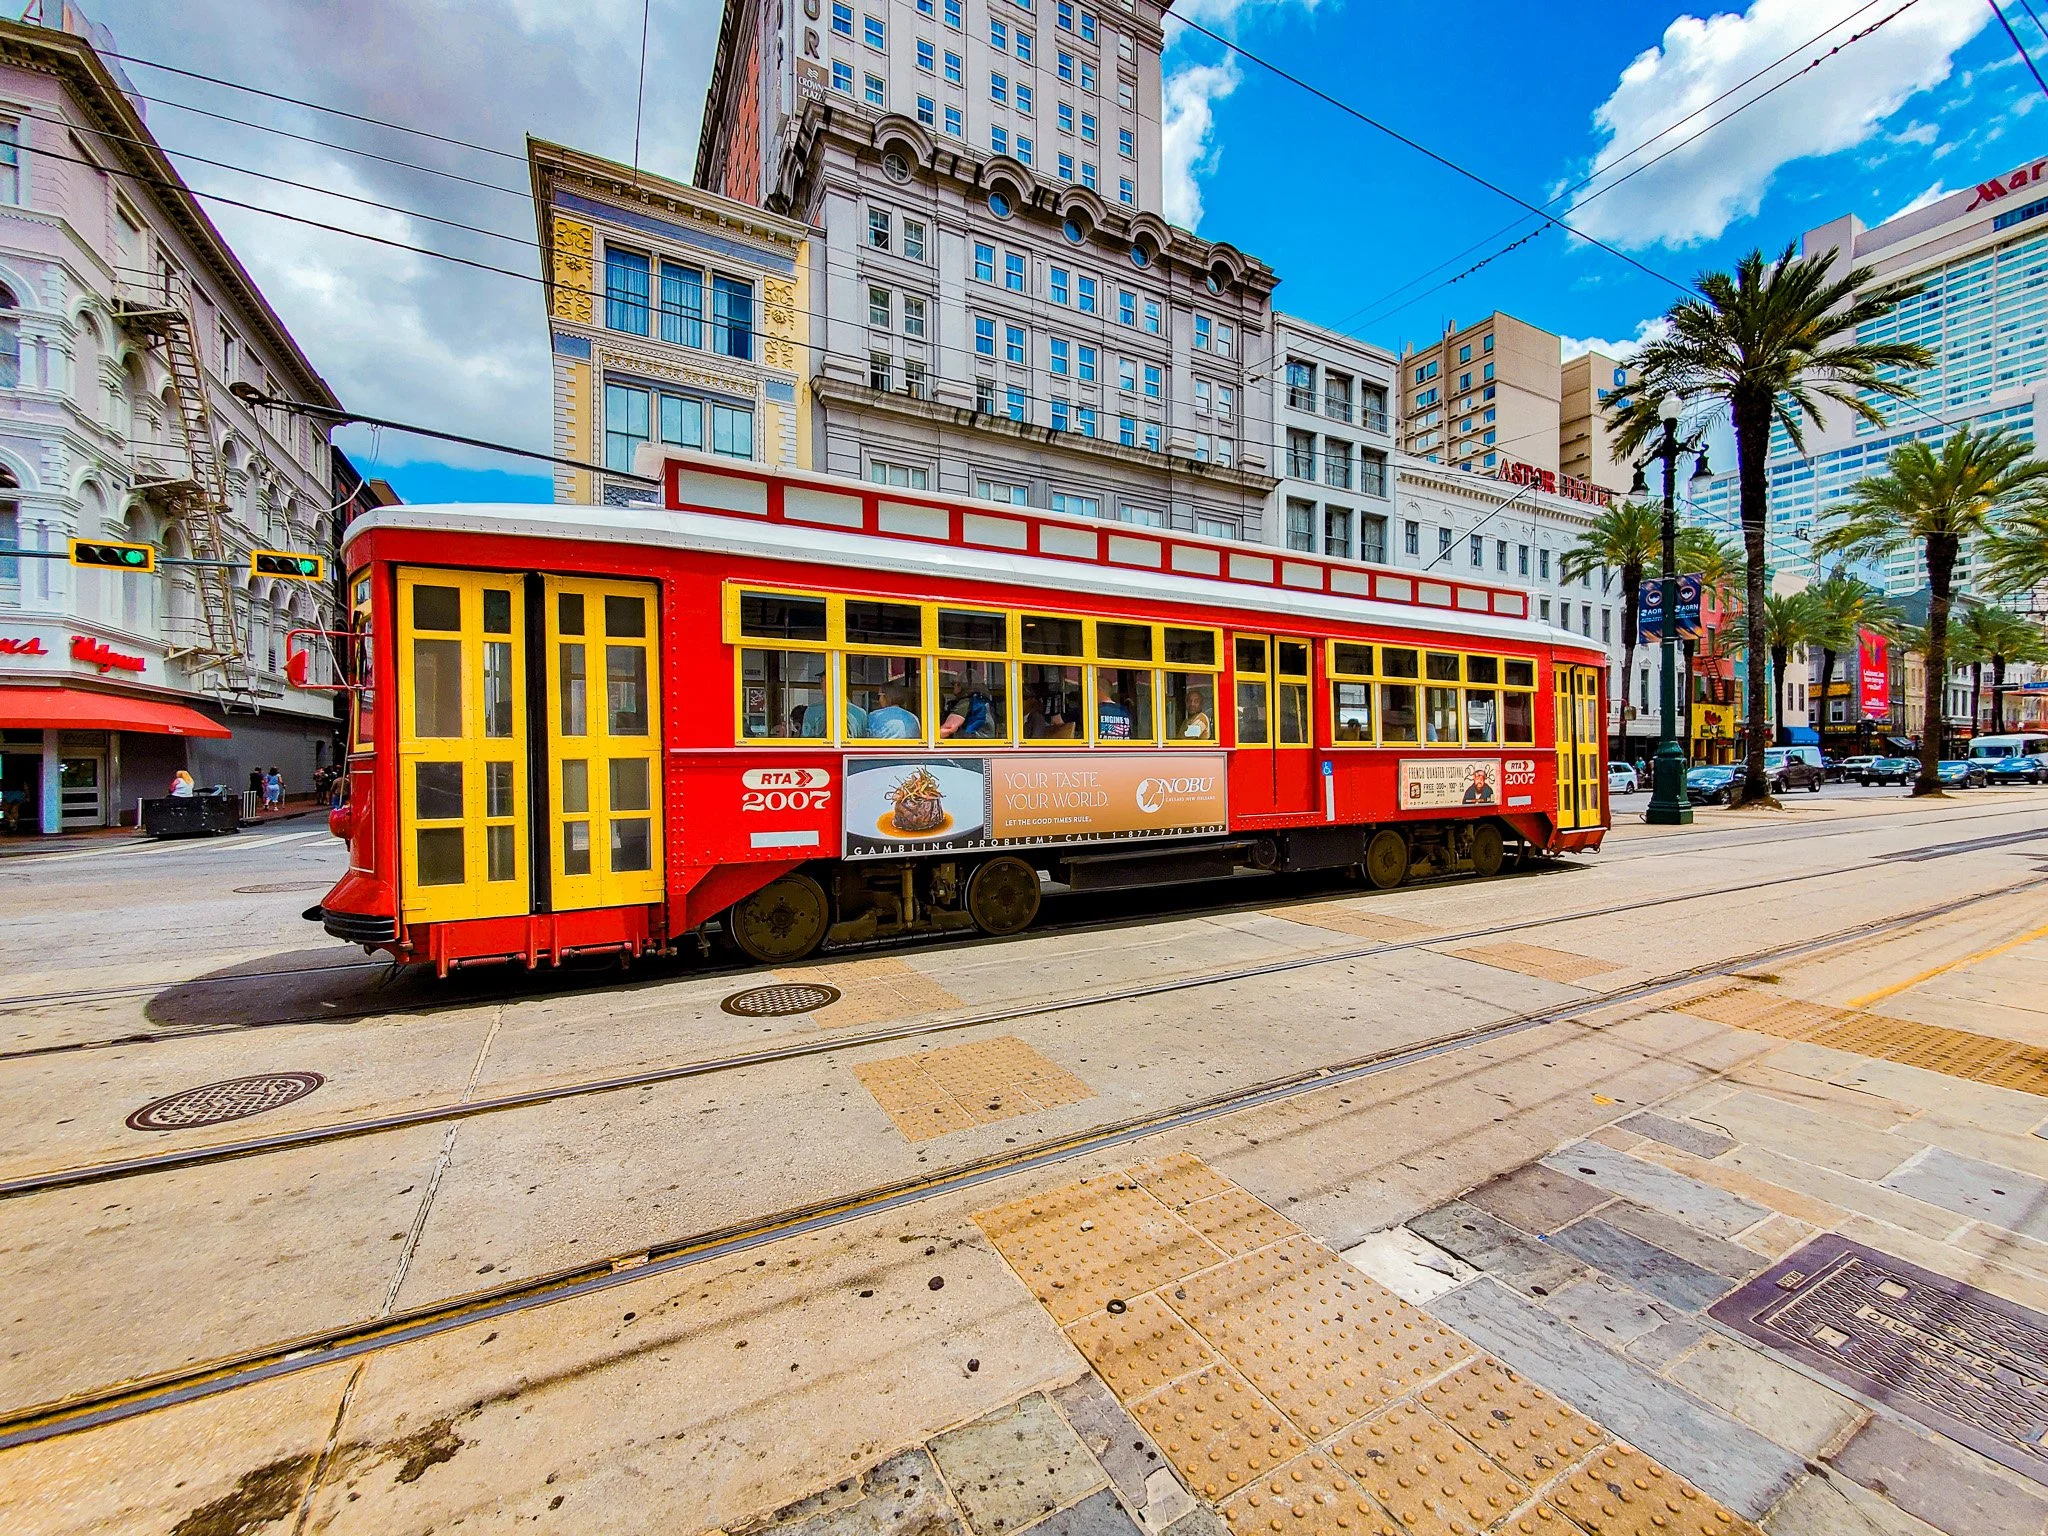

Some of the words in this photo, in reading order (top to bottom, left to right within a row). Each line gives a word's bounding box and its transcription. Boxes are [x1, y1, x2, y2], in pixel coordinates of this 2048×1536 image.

[798, 76, 823, 92] CROWN
[1498, 457, 1556, 494] ASTOR
[1100, 715, 1124, 724] ENGINE
[1510, 761, 1522, 770] RTA
[760, 772, 793, 785] RTA
[1004, 772, 1049, 790] YOUR
[1051, 771, 1102, 788] TASTE.
[1156, 777, 1215, 794] NOBU
[1505, 772, 1536, 785] 2007
[742, 790, 831, 812] 2007
[1005, 792, 1049, 810] YOUR
[1052, 791, 1109, 808] WORLD.
[1005, 819, 1017, 827] LET
[1018, 818, 1031, 826] THE
[1032, 817, 1053, 825] GOOD
[1053, 816, 1073, 824] TIMES
[853, 841, 953, 856] GAMBLING
[967, 835, 1053, 848] PROBLEM?
[1065, 832, 1102, 842] CALL
[1112, 825, 1224, 839] 1-877-770-STOP
